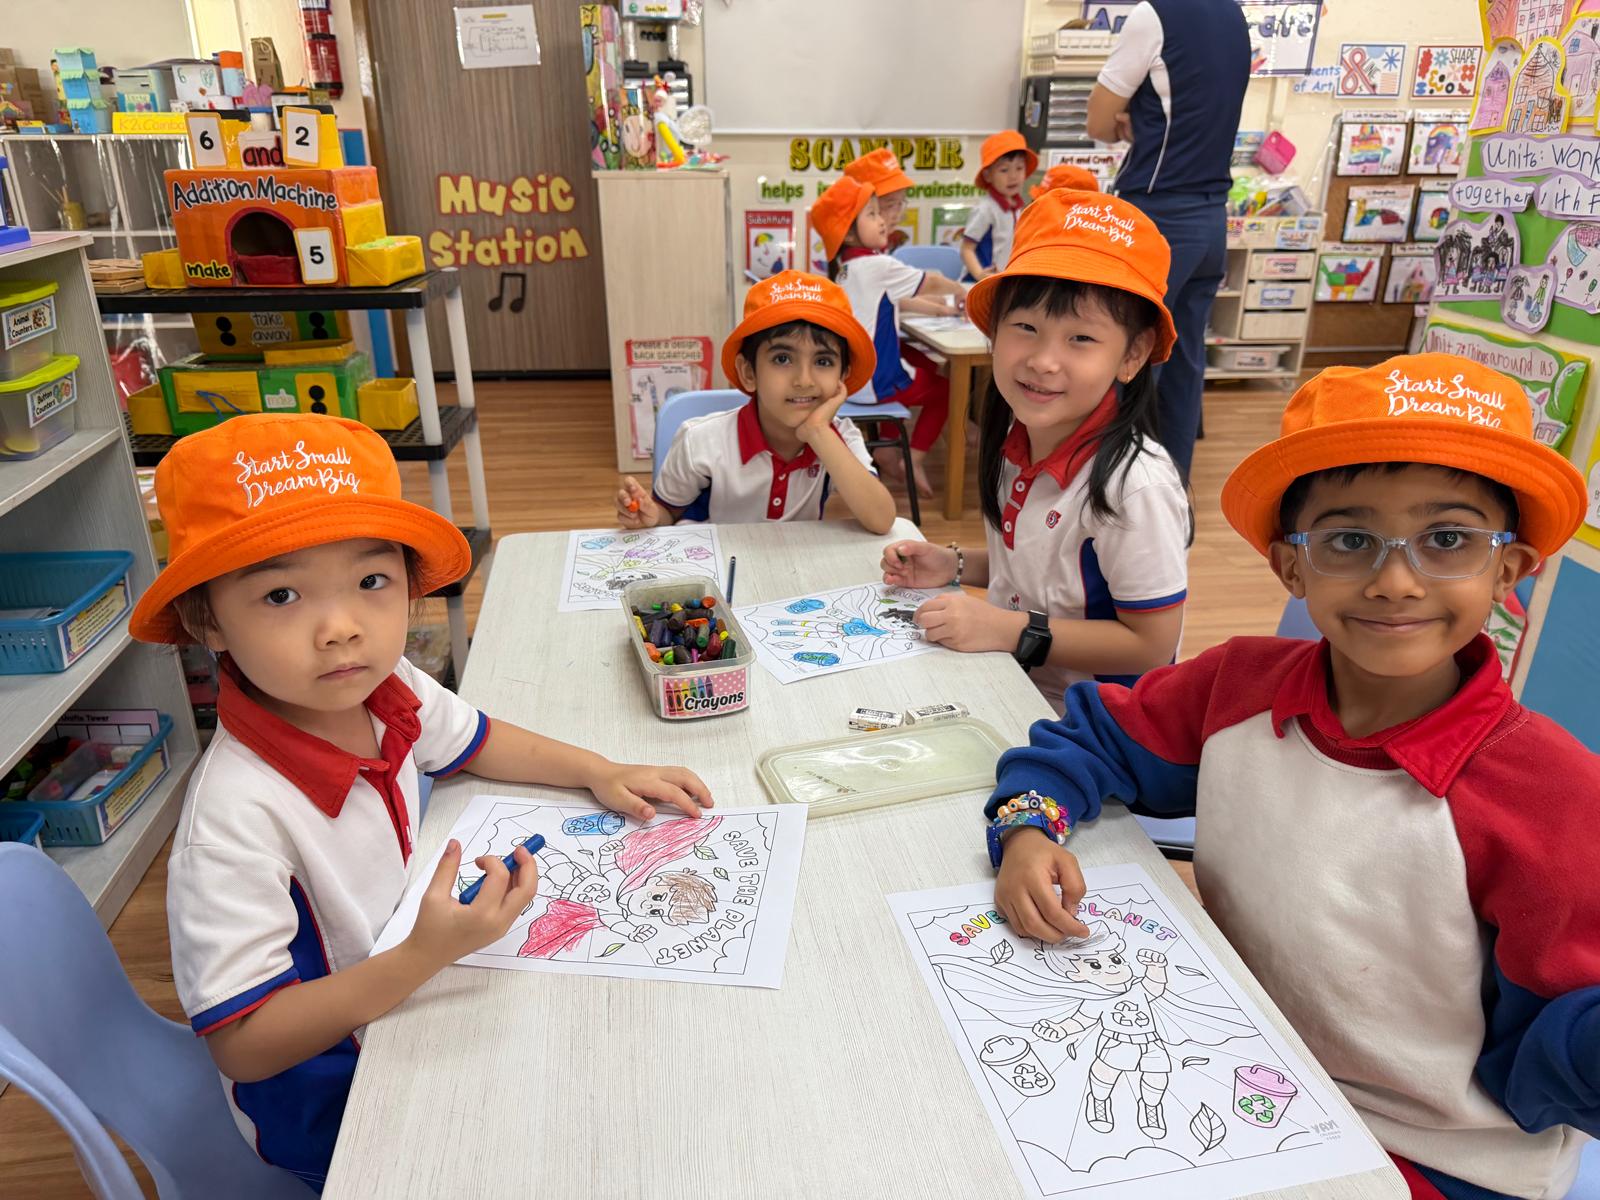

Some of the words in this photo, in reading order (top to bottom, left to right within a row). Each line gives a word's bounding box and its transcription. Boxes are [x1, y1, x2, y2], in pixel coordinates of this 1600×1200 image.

[1449, 48, 1477, 64] SHAPE
[1293, 79, 1307, 93] of
[1312, 80, 1333, 91] Art
[200, 131, 214, 149] 6
[295, 126, 309, 146] 2
[242, 135, 285, 167] and
[172, 178, 254, 210] Addition
[257, 175, 338, 210] Machine
[438, 173, 576, 217] Music
[761, 180, 804, 203] helps
[1456, 185, 1534, 206] together
[1065, 204, 1102, 219] Start
[1100, 205, 1135, 232] Small
[1063, 215, 1109, 234] Dream
[1108, 225, 1135, 247] Big
[309, 246, 325, 264] 5
[428, 226, 589, 268] Station
[186, 261, 231, 279] make
[795, 278, 822, 292] Small
[252, 311, 284, 328] take
[252, 328, 292, 342] away
[1540, 360, 1553, 377] us
[1384, 369, 1449, 394] Start
[1447, 374, 1506, 411] Small
[1386, 392, 1466, 417] Dream
[232, 450, 295, 484] Start
[293, 440, 352, 470] Small
[241, 475, 319, 509] Dream
[316, 467, 361, 495] Big
[684, 691, 744, 711] Crayons
[723, 831, 759, 868] SAVE
[733, 873, 760, 906] THE
[949, 910, 1008, 947] SAVE
[1076, 901, 1178, 941] PLANET
[656, 908, 745, 966] PLANET
